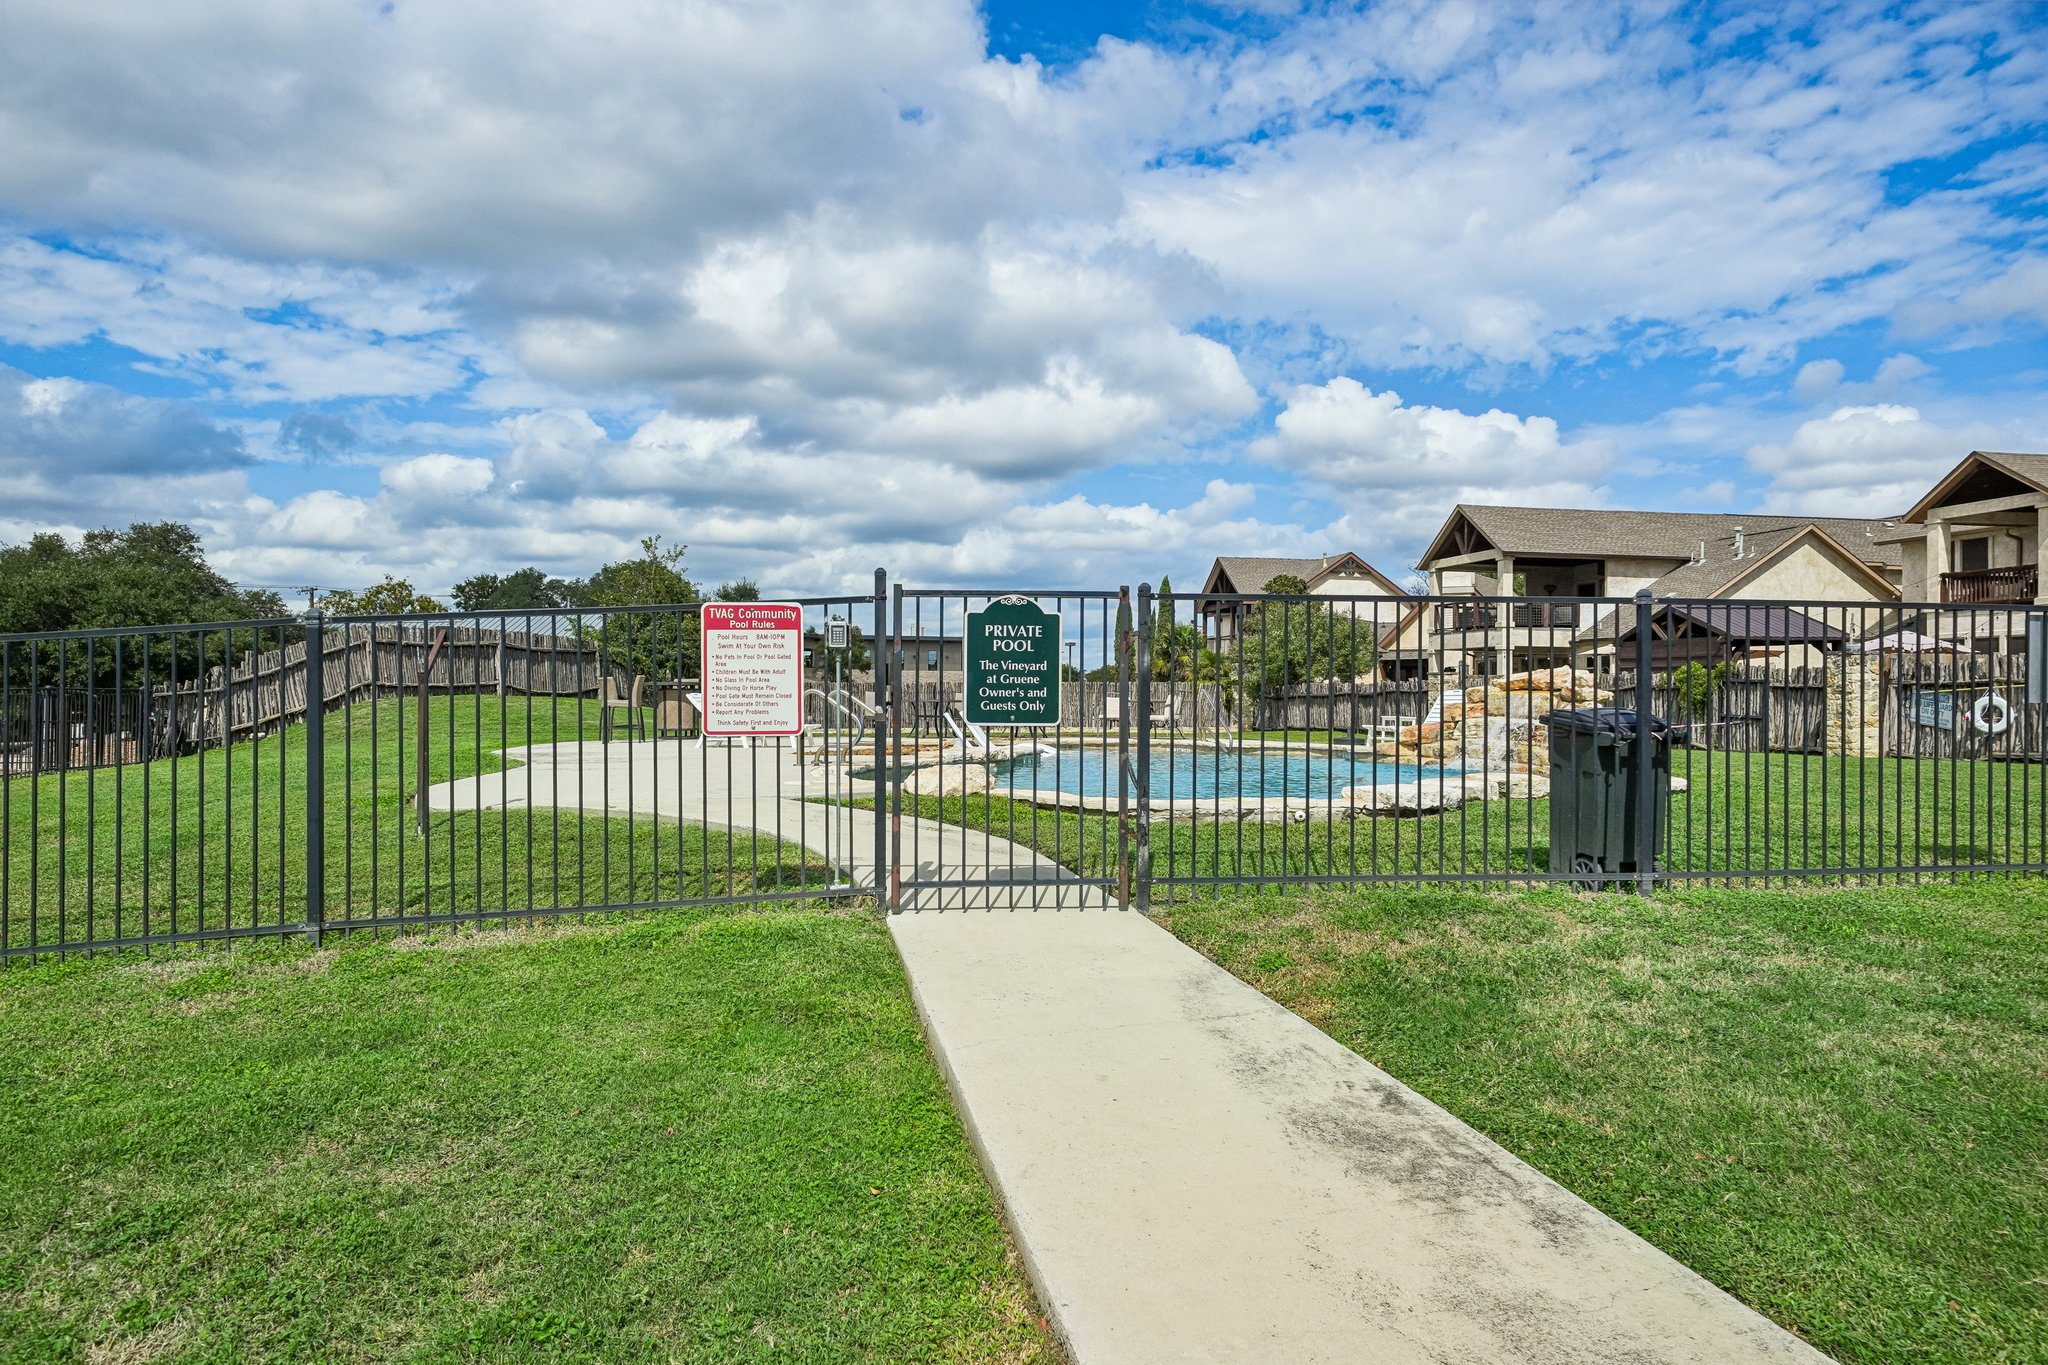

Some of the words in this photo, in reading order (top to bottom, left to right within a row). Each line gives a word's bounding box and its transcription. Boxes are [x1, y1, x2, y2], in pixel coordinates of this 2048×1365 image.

[709, 608, 734, 619] TVAG
[739, 608, 796, 621] Community
[730, 620, 748, 628] Pool
[752, 620, 775, 628] Rules
[985, 625, 1042, 637] PRIVATE
[993, 639, 1034, 652] POOL
[979, 660, 998, 670] The
[1001, 660, 1047, 673] Vineyard
[987, 675, 997, 684] at
[1000, 674, 1040, 684] Gruene
[979, 687, 1024, 697] Owner's
[1027, 687, 1047, 697] and
[981, 701, 1016, 711] Guests
[1020, 700, 1045, 713] Only
